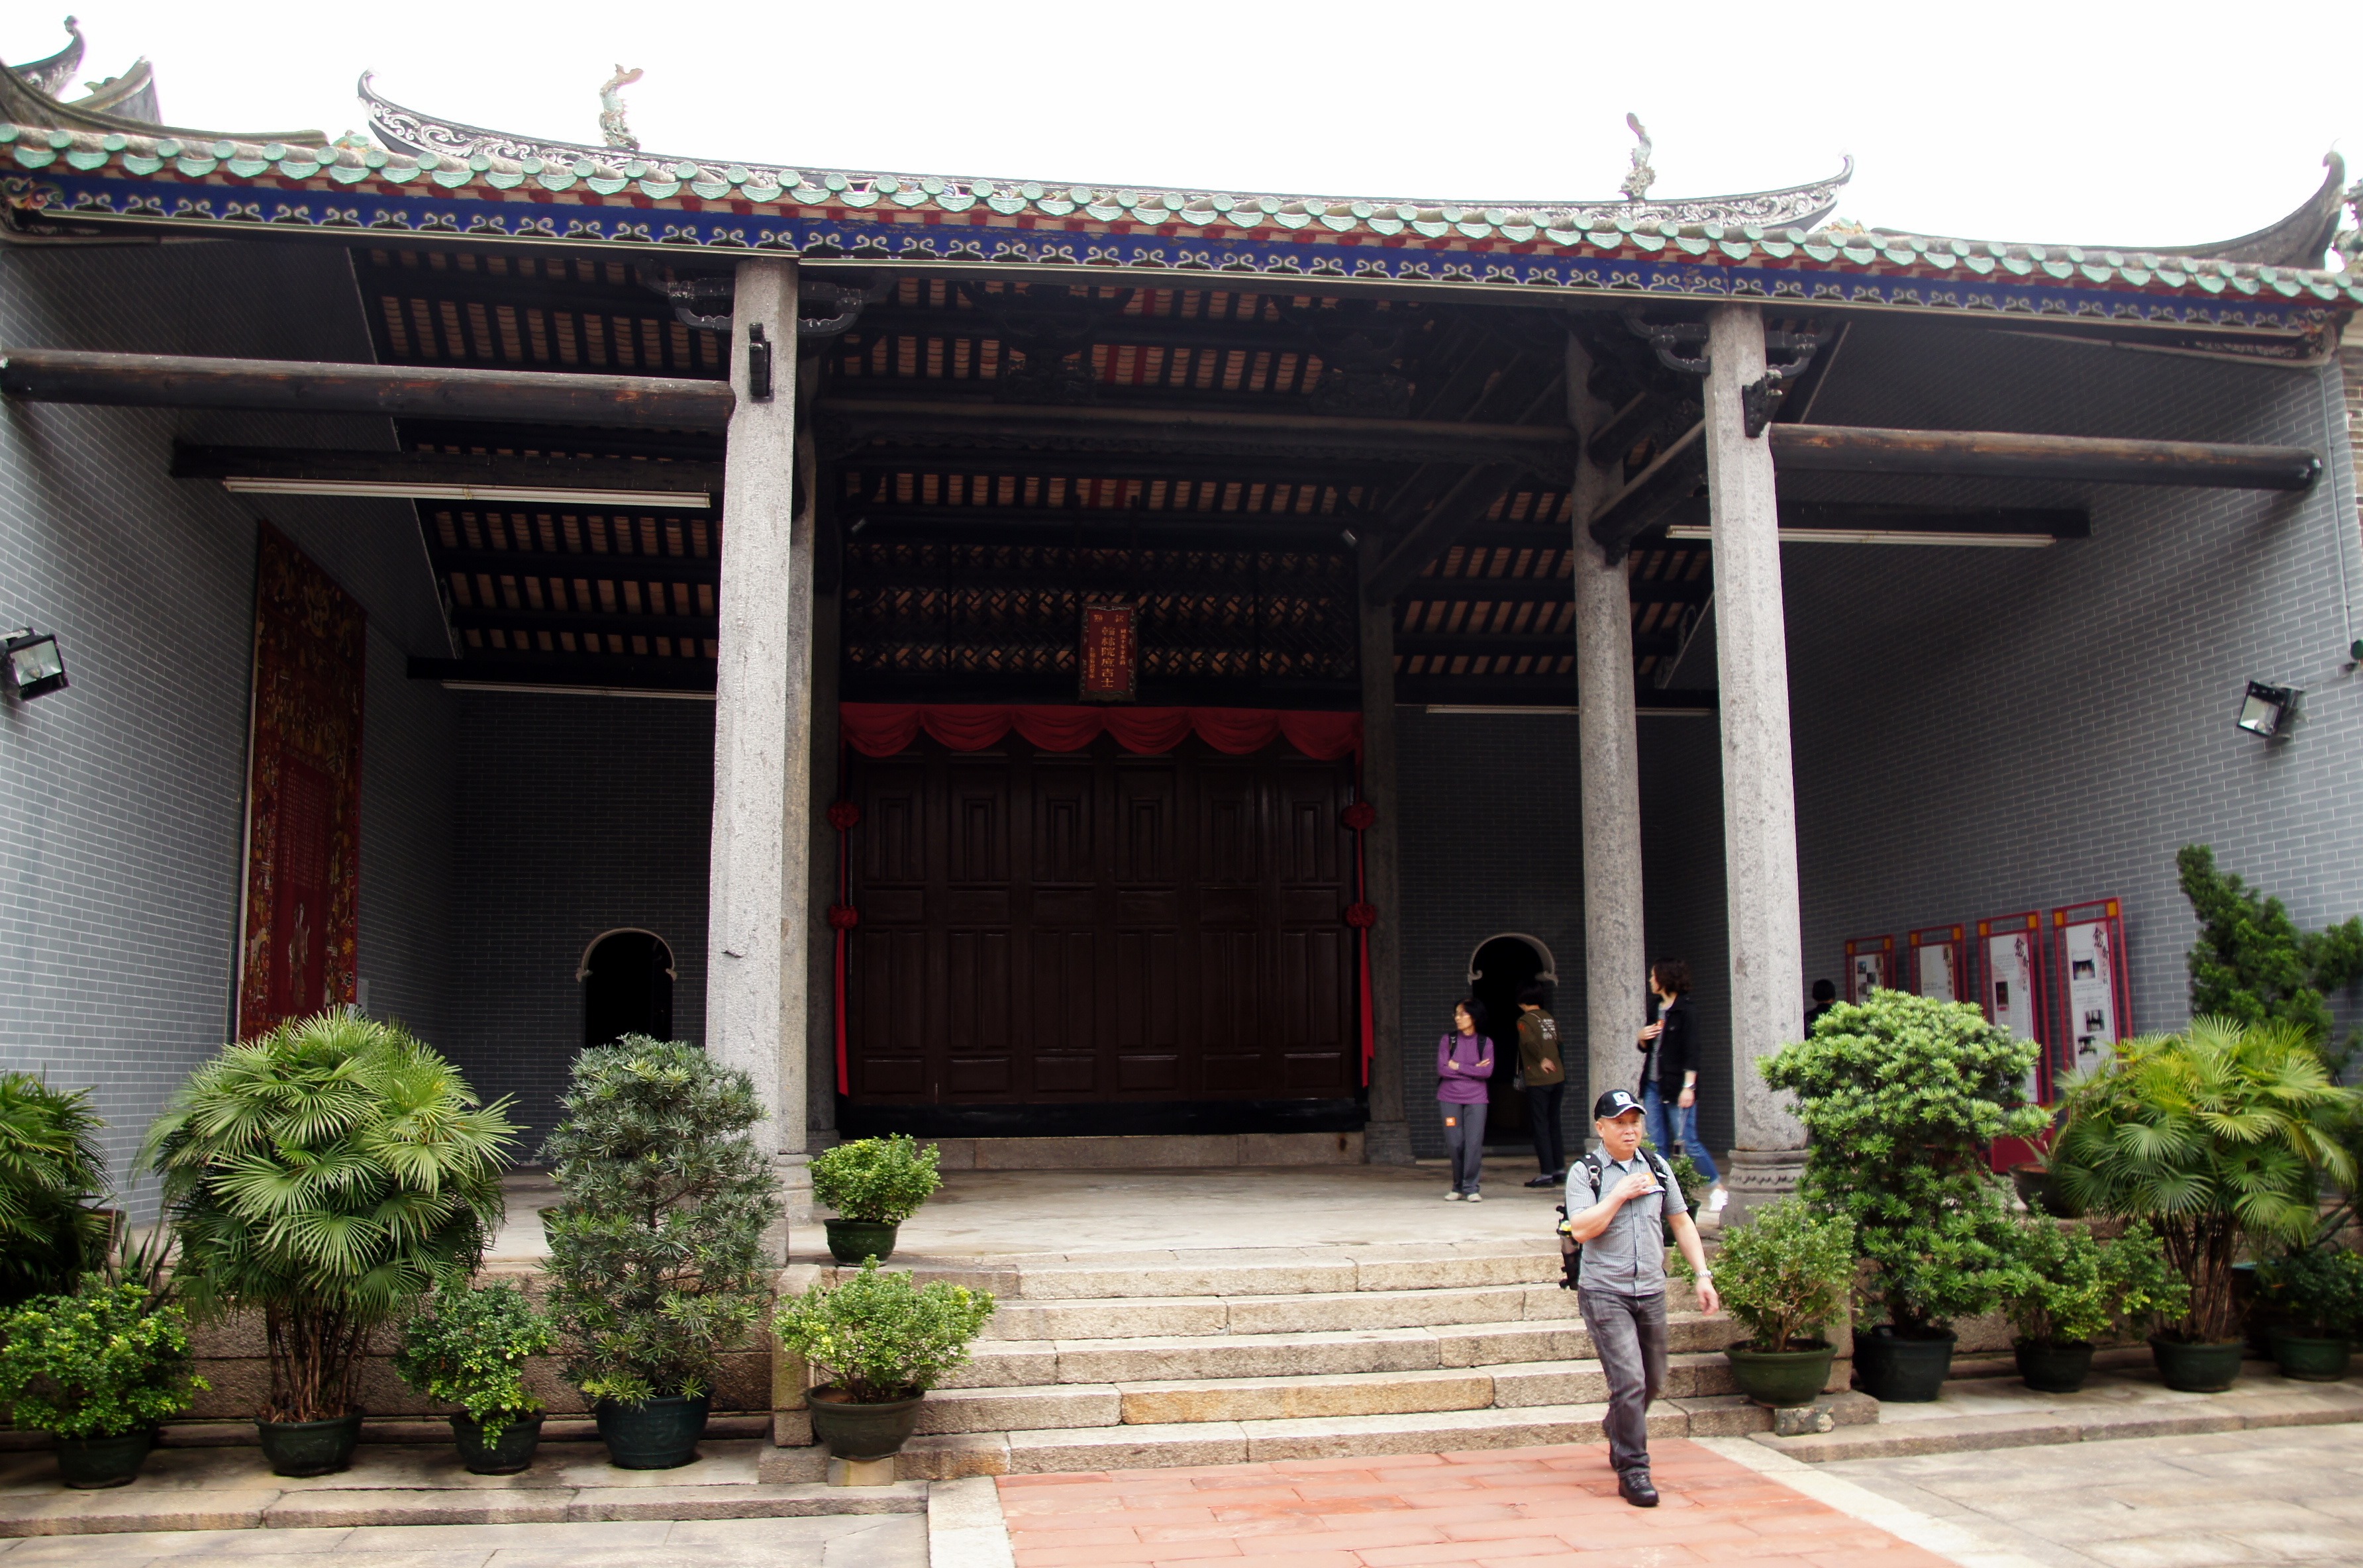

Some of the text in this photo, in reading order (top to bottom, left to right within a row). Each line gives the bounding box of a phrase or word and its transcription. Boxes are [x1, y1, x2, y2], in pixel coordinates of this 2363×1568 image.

[1101, 626, 1115, 687] 翰林院庶吉士
